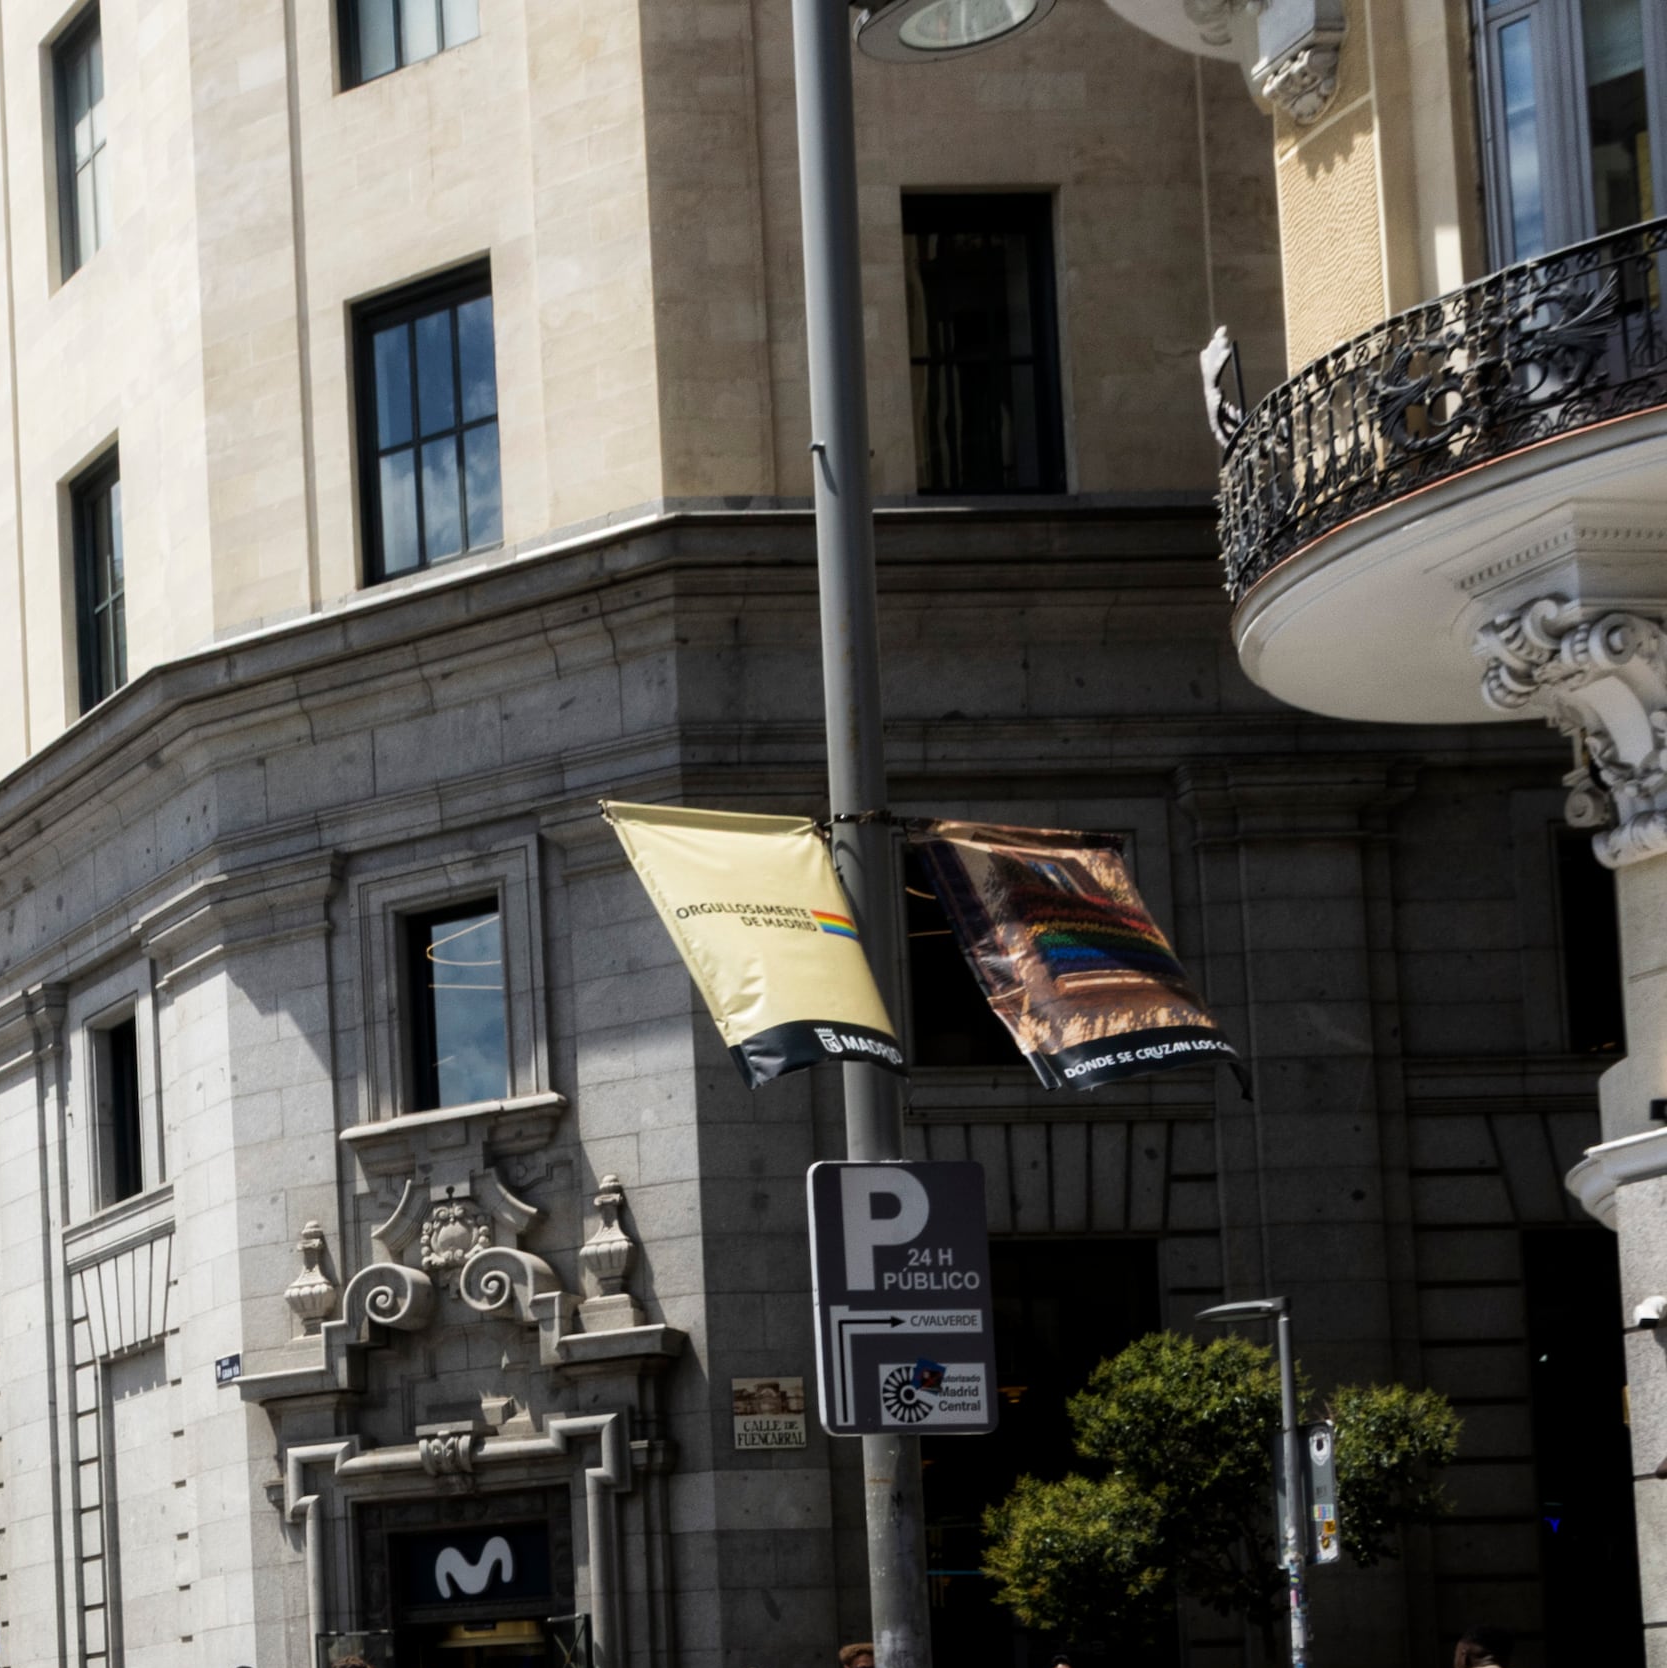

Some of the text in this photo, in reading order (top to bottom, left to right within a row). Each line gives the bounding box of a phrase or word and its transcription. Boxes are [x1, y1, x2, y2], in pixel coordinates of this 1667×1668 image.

[676, 903, 811, 920] ORGULLOSAMENTE
[741, 916, 818, 932] DE MADRID
[840, 1035, 904, 1066] MADRID
[1063, 1054, 1116, 1079] DONDE
[1116, 1051, 1134, 1064] SE
[1135, 1041, 1191, 1059] CRUZAN
[1191, 1039, 1216, 1050] LOS
[840, 1167, 930, 1291] P
[907, 1248, 953, 1267] 24 H
[883, 1267, 980, 1291] PÚBLICO
[910, 1315, 978, 1327] C/VALVERDE
[941, 1374, 981, 1384] utorizado
[938, 1385, 979, 1398] Madrid
[938, 1400, 981, 1412] Central
[743, 1420, 782, 1433] CALLE
[738, 1432, 805, 1446] FUENCARRAL
